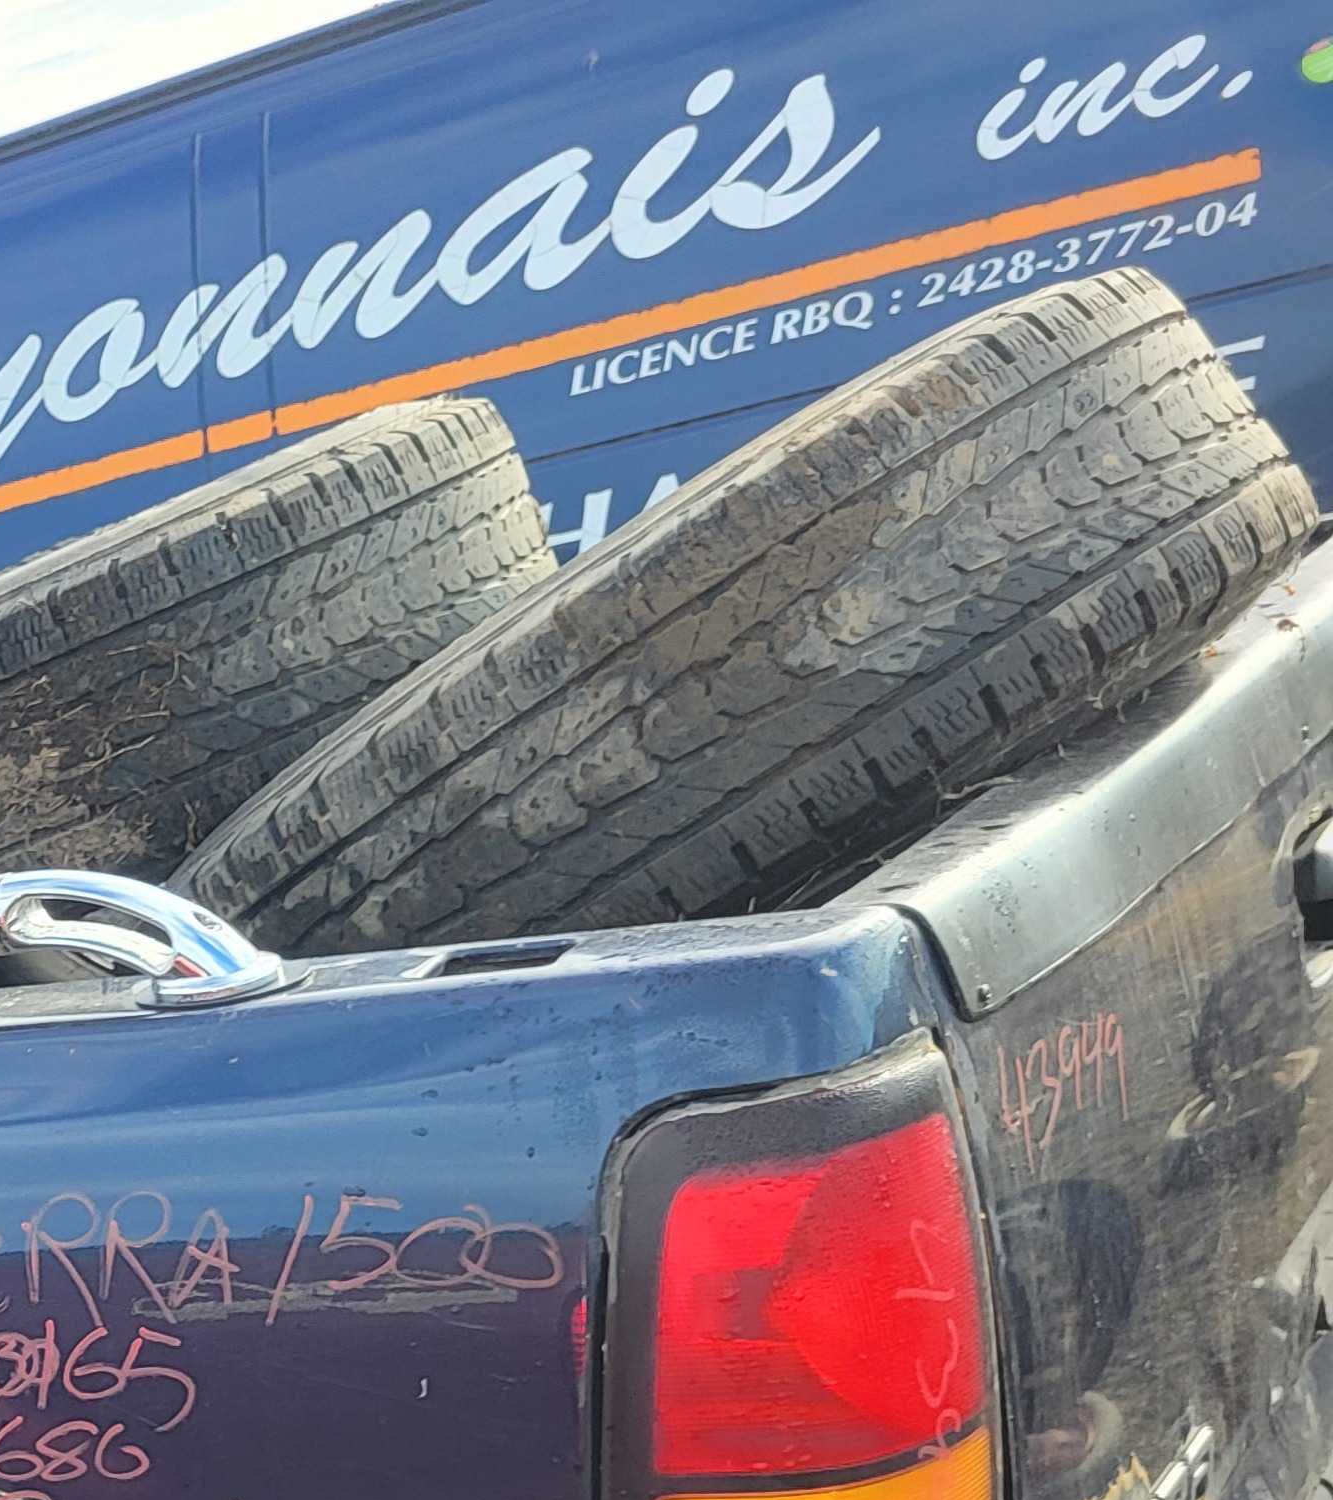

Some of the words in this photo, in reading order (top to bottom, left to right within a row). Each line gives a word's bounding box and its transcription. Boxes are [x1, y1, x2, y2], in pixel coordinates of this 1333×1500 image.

[976, 34, 1254, 160] inc.
[569, 318, 759, 397] LICENCE
[770, 290, 875, 346] RBQ
[917, 191, 1258, 310] 2428-3772-04
